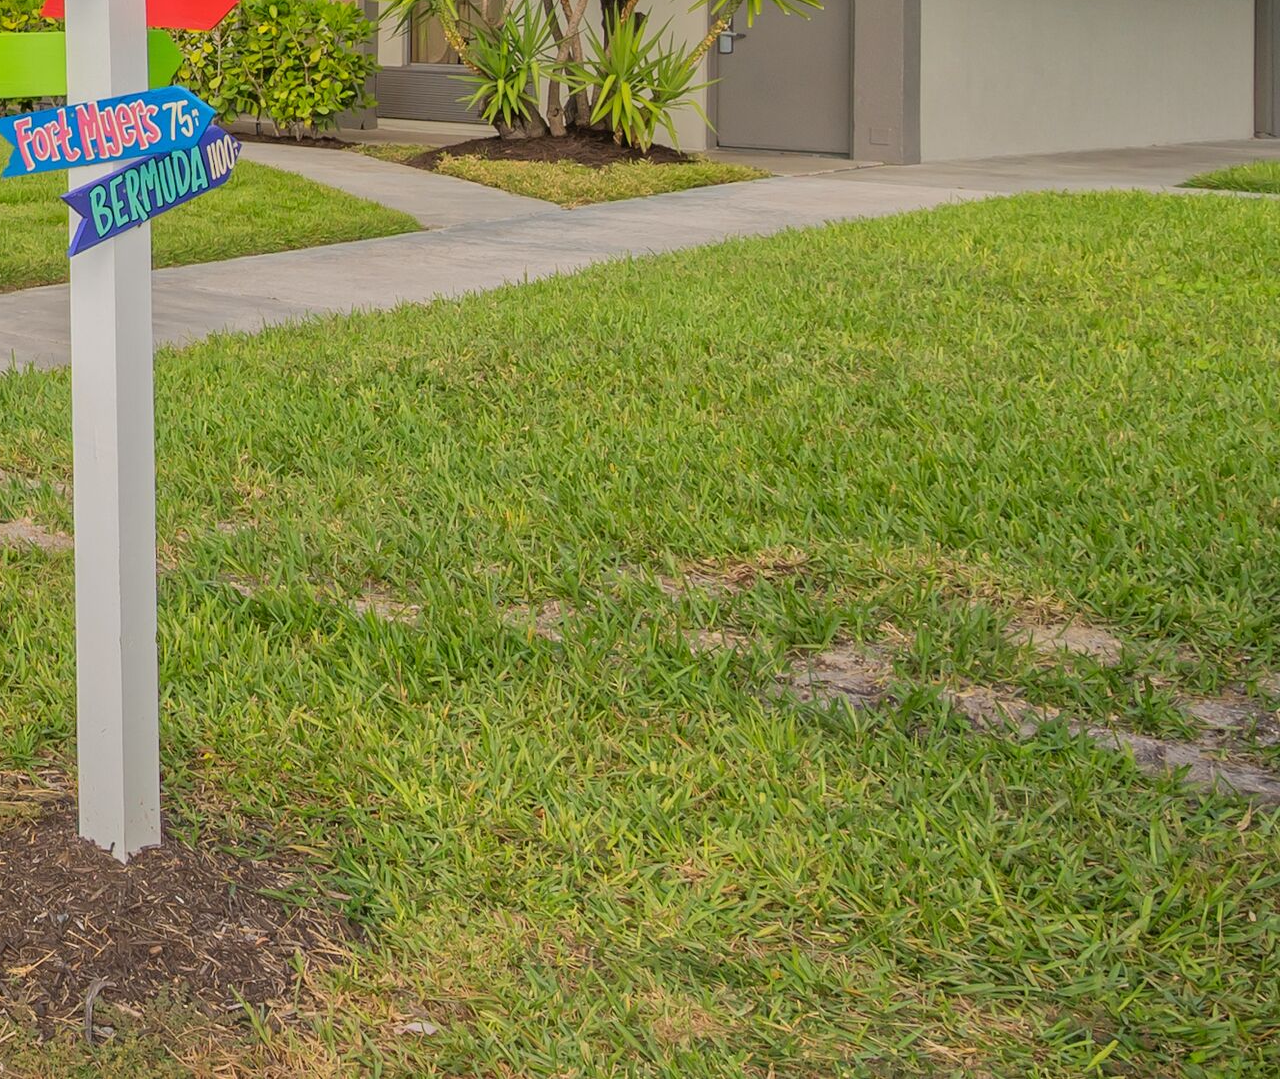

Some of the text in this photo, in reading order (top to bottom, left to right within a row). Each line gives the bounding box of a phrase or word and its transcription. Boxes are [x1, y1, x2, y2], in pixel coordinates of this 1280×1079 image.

[12, 97, 194, 172] Fort Myers 75
[89, 144, 210, 239] BERMUDA
